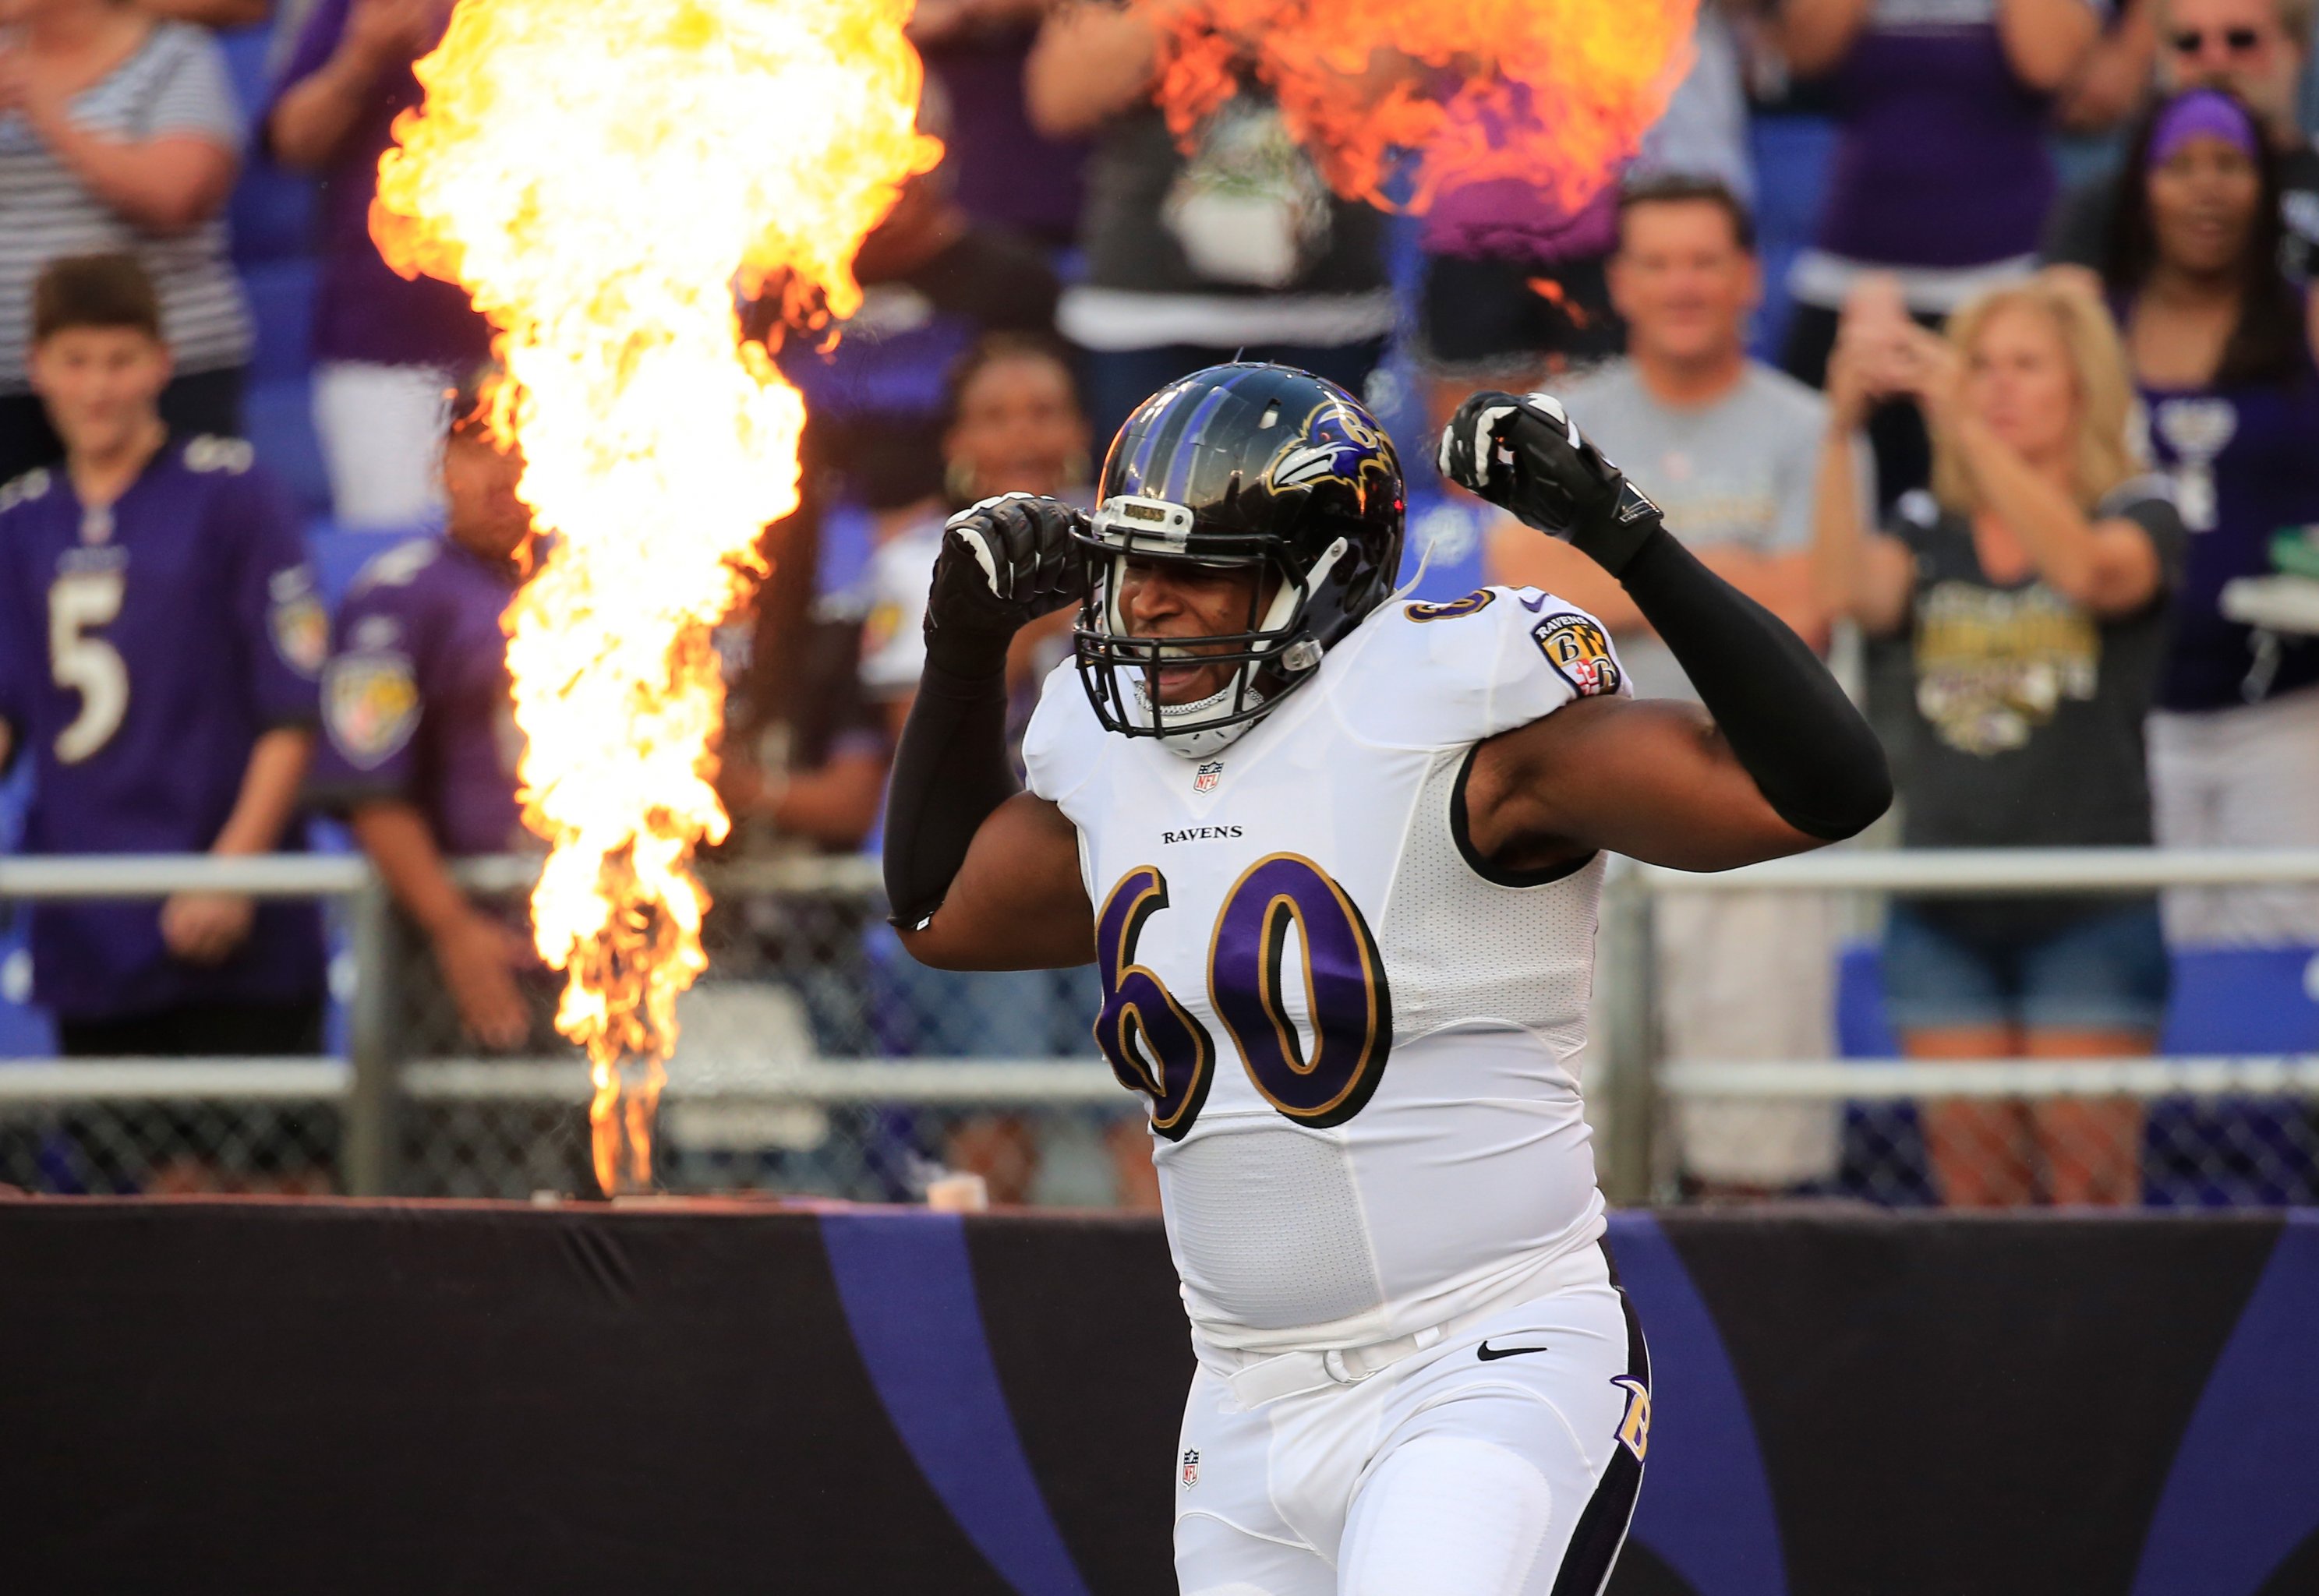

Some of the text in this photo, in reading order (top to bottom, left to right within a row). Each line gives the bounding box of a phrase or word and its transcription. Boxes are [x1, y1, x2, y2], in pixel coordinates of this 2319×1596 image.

[1535, 616, 1589, 639] RAVENS
[1547, 631, 1579, 663] B
[48, 573, 130, 766] 5
[1197, 774, 1217, 789] NFL
[1161, 825, 1243, 845] RAVENS
[1094, 852, 1393, 1142] 60
[1183, 1465, 1197, 1481] NFL
